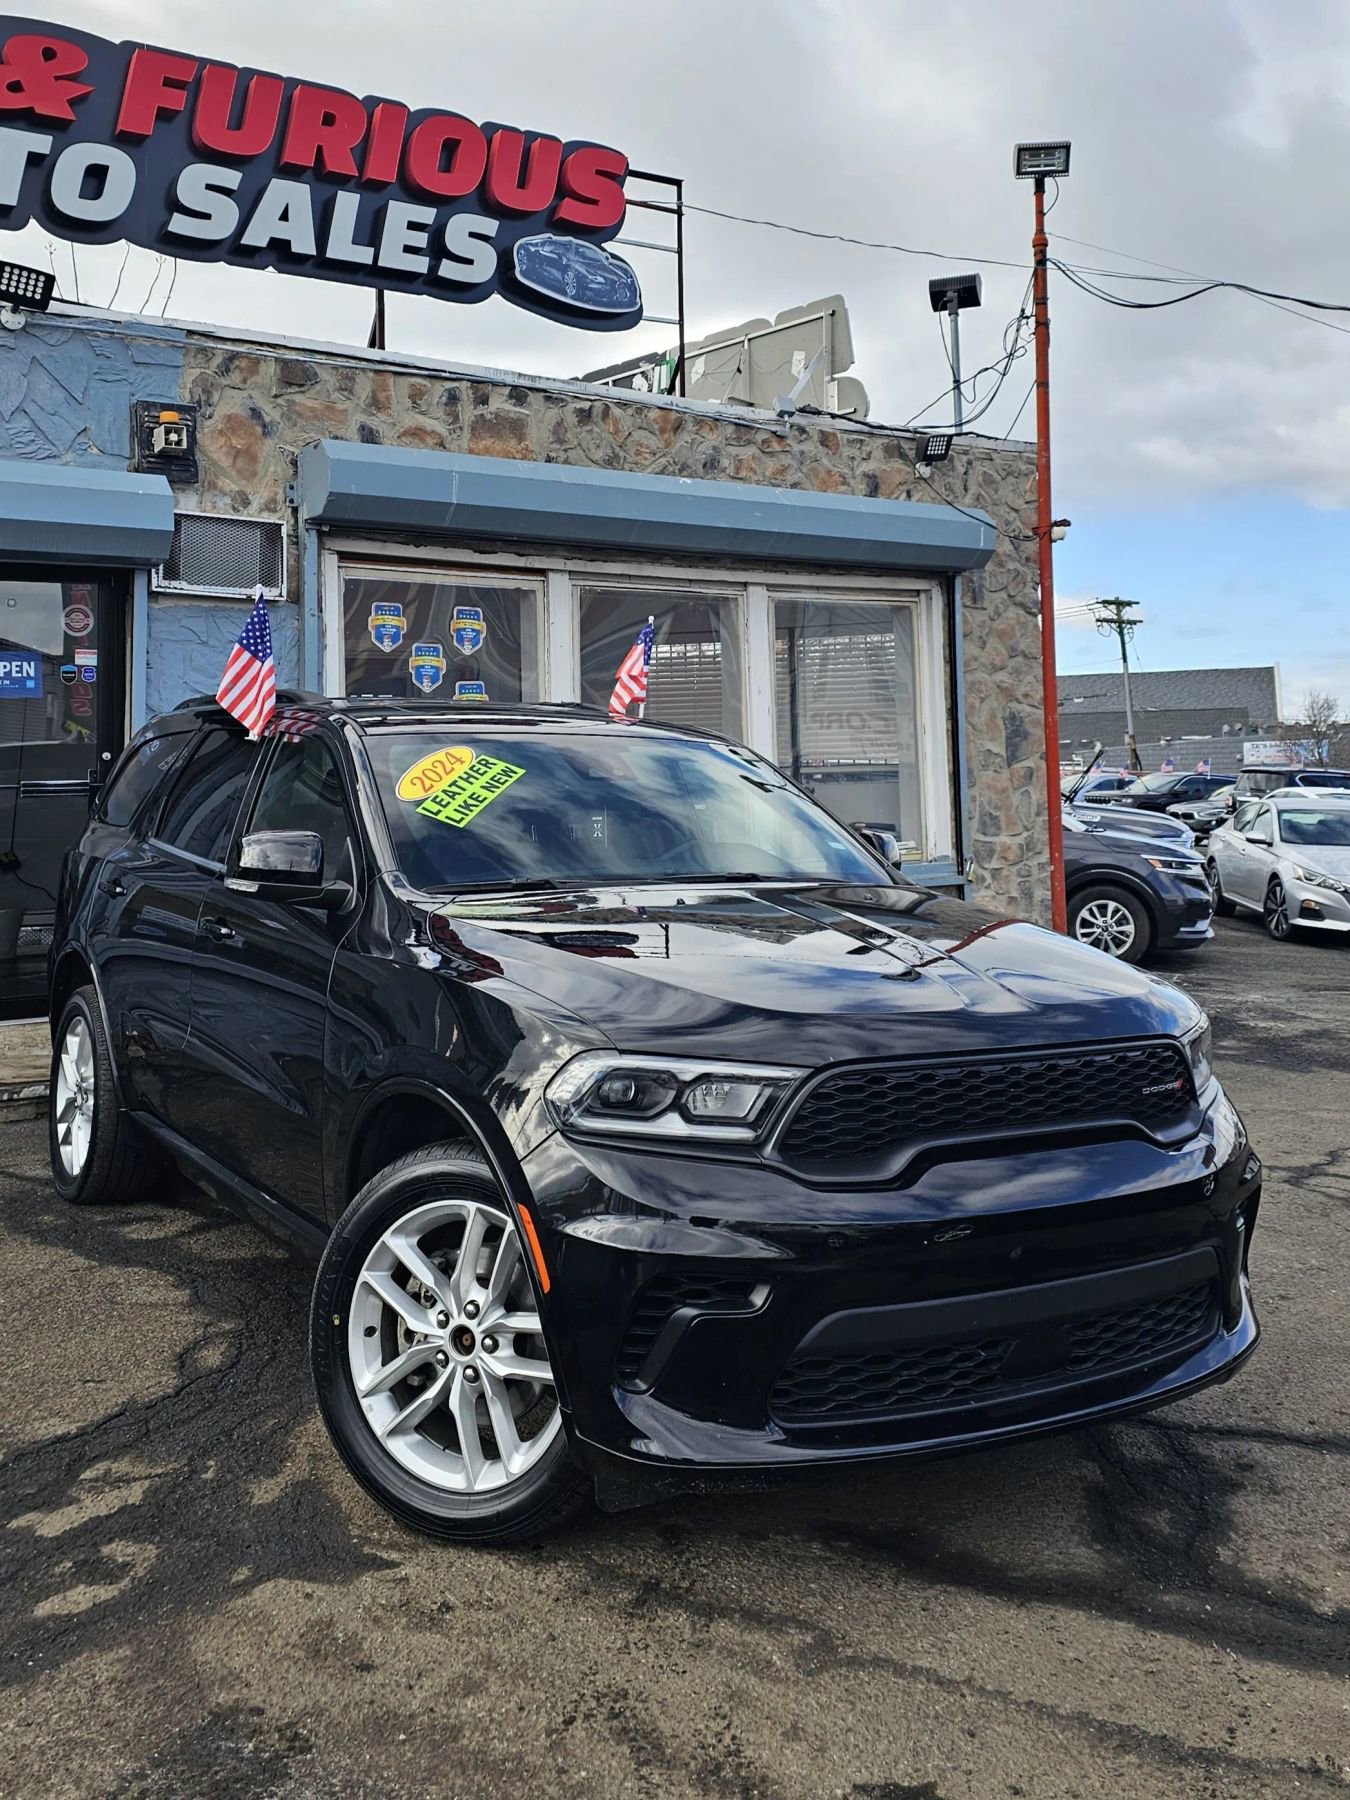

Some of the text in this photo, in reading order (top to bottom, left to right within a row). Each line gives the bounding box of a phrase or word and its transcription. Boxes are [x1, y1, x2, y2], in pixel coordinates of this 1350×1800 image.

[0, 34, 628, 228] & FURIOUS
[166, 162, 500, 285] SALES
[410, 751, 466, 793] 2024
[421, 757, 498, 817] LEATHER
[445, 766, 519, 825] LIKE NEW
